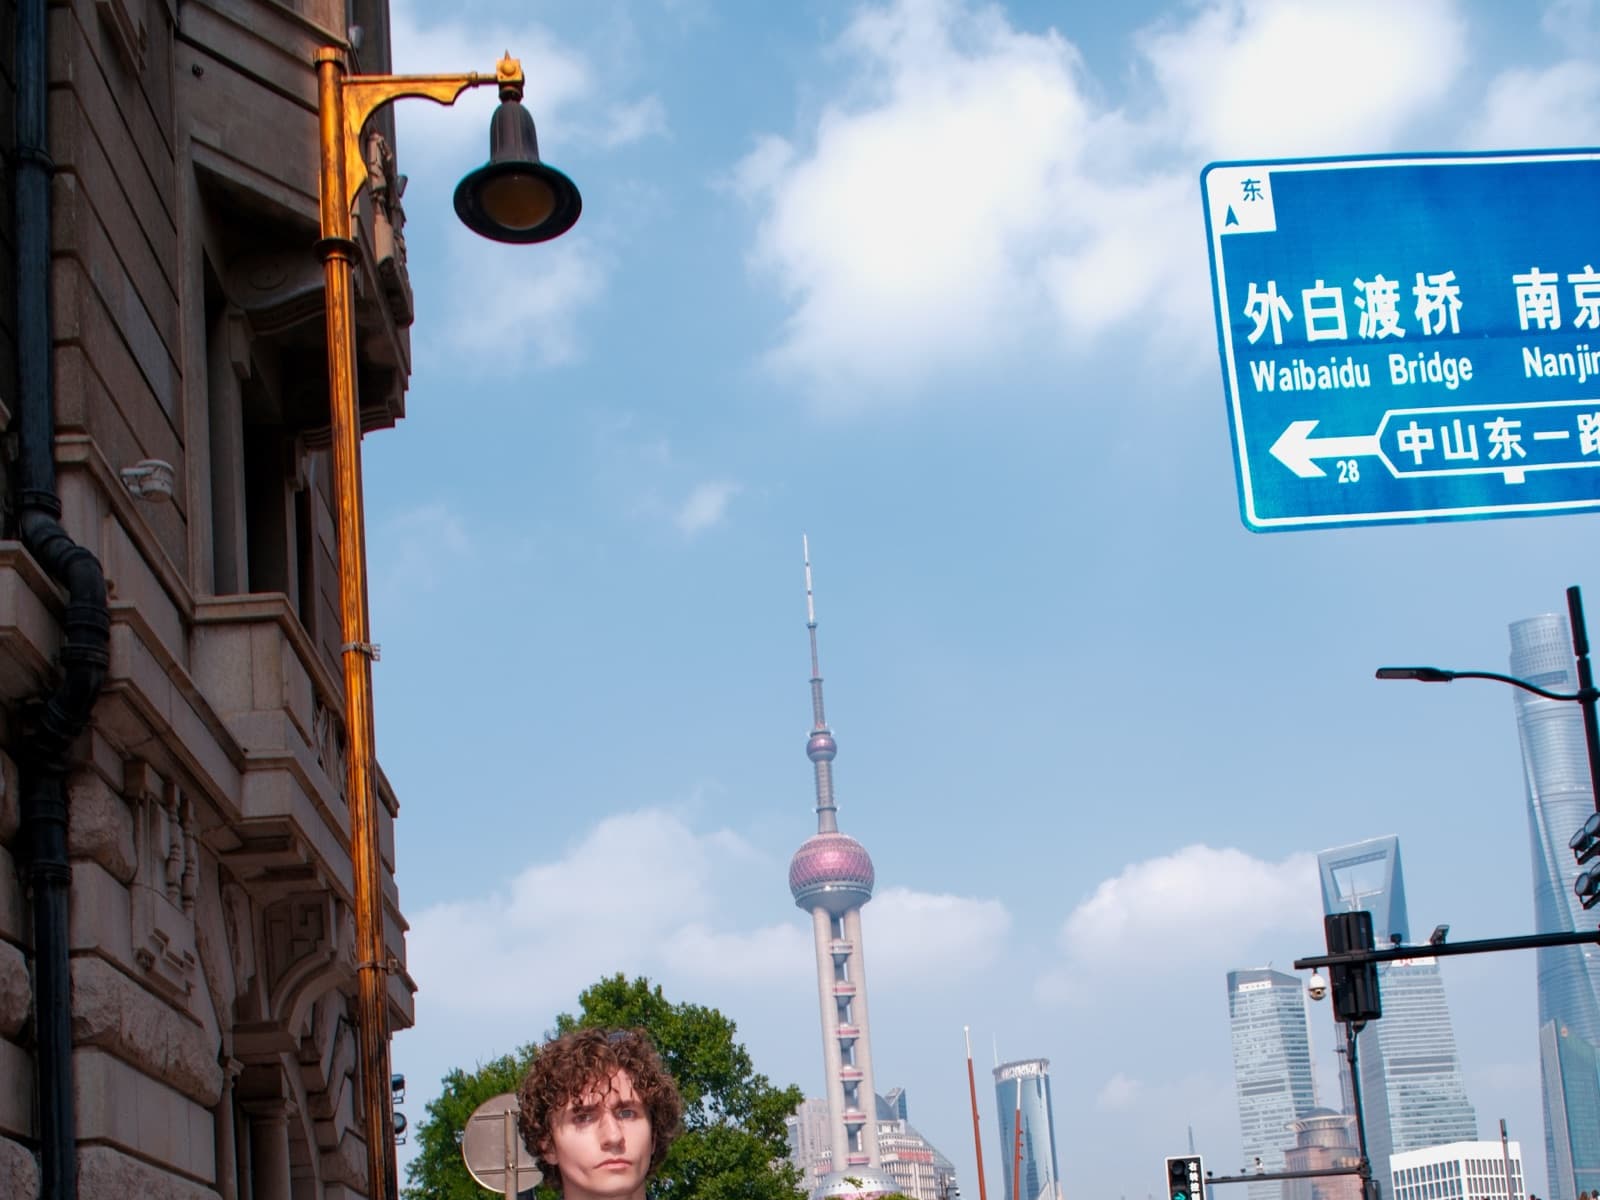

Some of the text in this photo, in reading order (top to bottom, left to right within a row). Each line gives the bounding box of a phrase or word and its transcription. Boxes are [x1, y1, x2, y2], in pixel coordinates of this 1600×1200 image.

[1241, 178, 1264, 201] 东
[1243, 264, 1600, 345] 外白渡桥 南京
[1250, 357, 1371, 393] Waibaidu
[1389, 351, 1473, 390] Bridge
[1397, 412, 1600, 465] 中山东一路
[1336, 460, 1360, 484] 28
